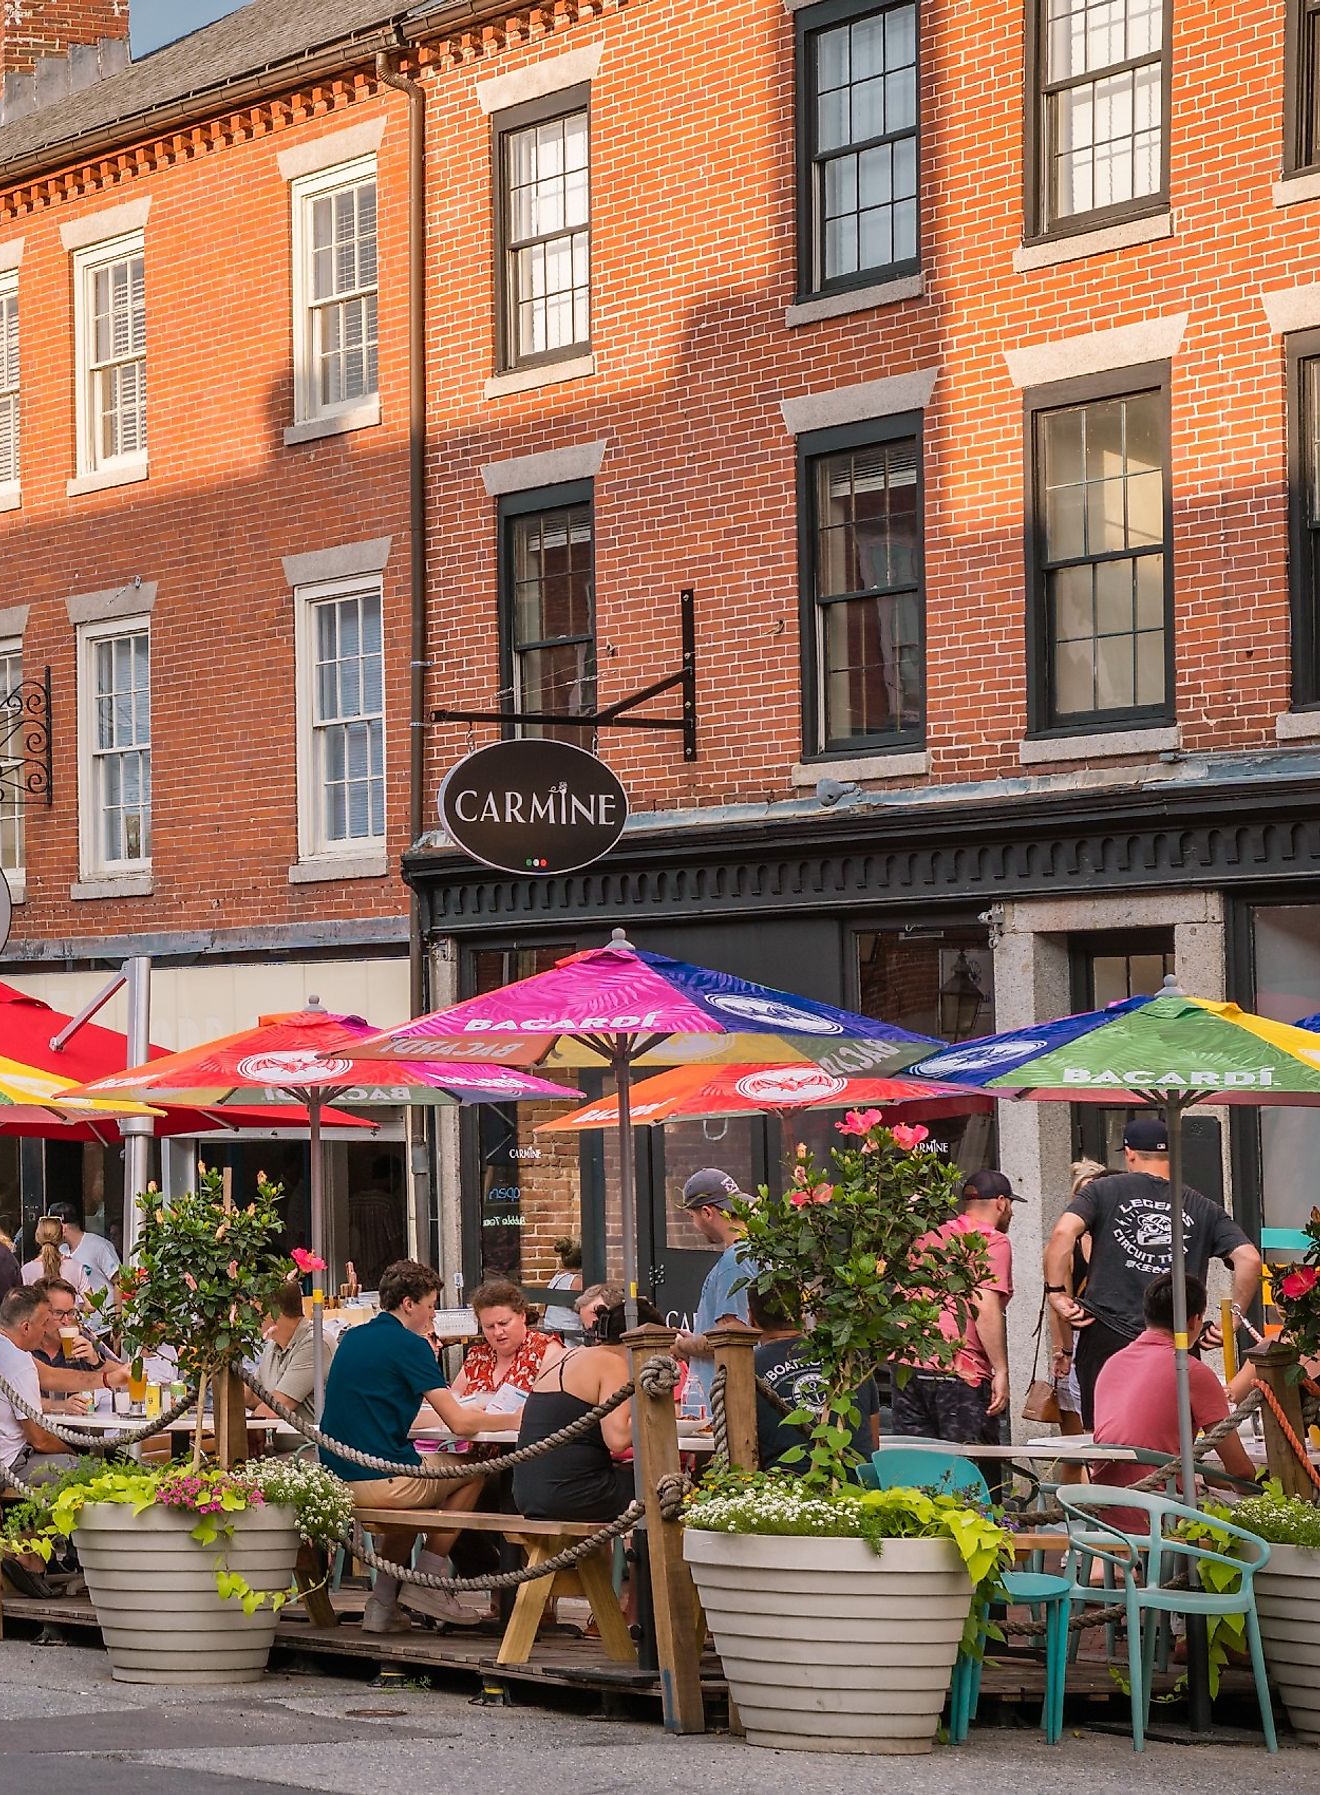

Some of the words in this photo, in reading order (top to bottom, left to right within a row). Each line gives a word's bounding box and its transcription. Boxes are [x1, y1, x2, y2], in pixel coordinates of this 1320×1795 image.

[455, 782, 616, 825] CARMINE
[509, 1146, 542, 1158] CARMINE
[1113, 1228, 1155, 1263] CIRCUIT
